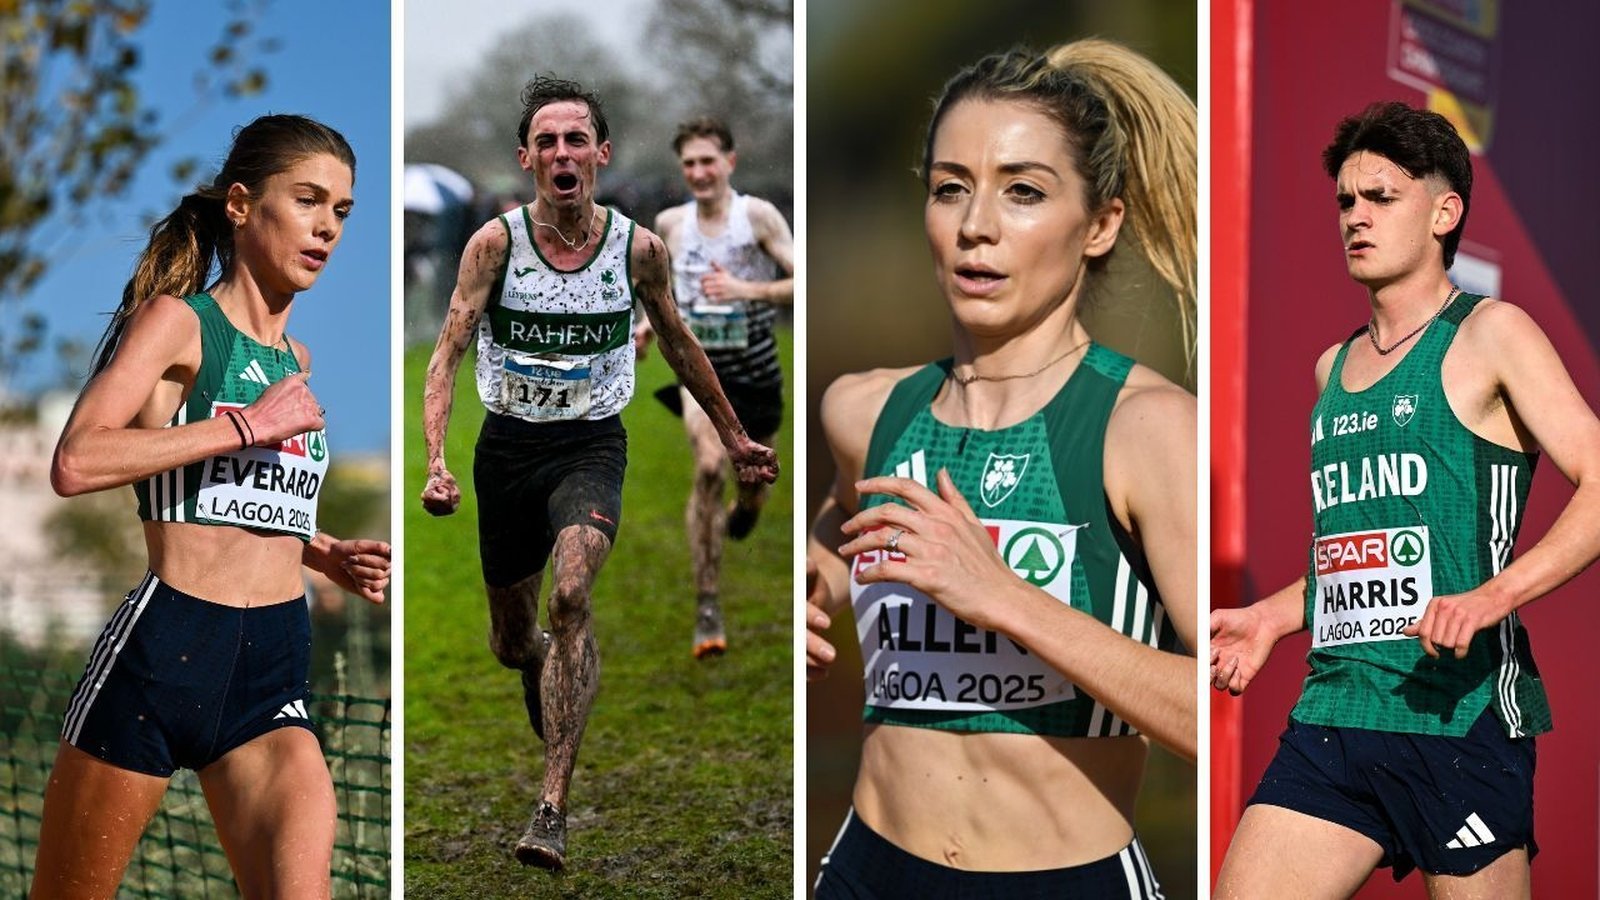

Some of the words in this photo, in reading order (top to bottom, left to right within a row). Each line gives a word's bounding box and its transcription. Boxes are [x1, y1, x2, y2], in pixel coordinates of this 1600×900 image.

[510, 320, 617, 346] RAHENY
[516, 384, 571, 408] 171
[1332, 410, 1379, 437] 123.ie
[209, 455, 320, 500] EVERARD
[1310, 453, 1428, 514] RELAND
[212, 496, 285, 525] LAGOA
[1317, 537, 1386, 571] SPAR
[1323, 576, 1419, 614] HARRIS
[1320, 620, 1365, 643] LAGOA
[871, 670, 947, 702] LAGOA
[956, 673, 1046, 704] 2025
